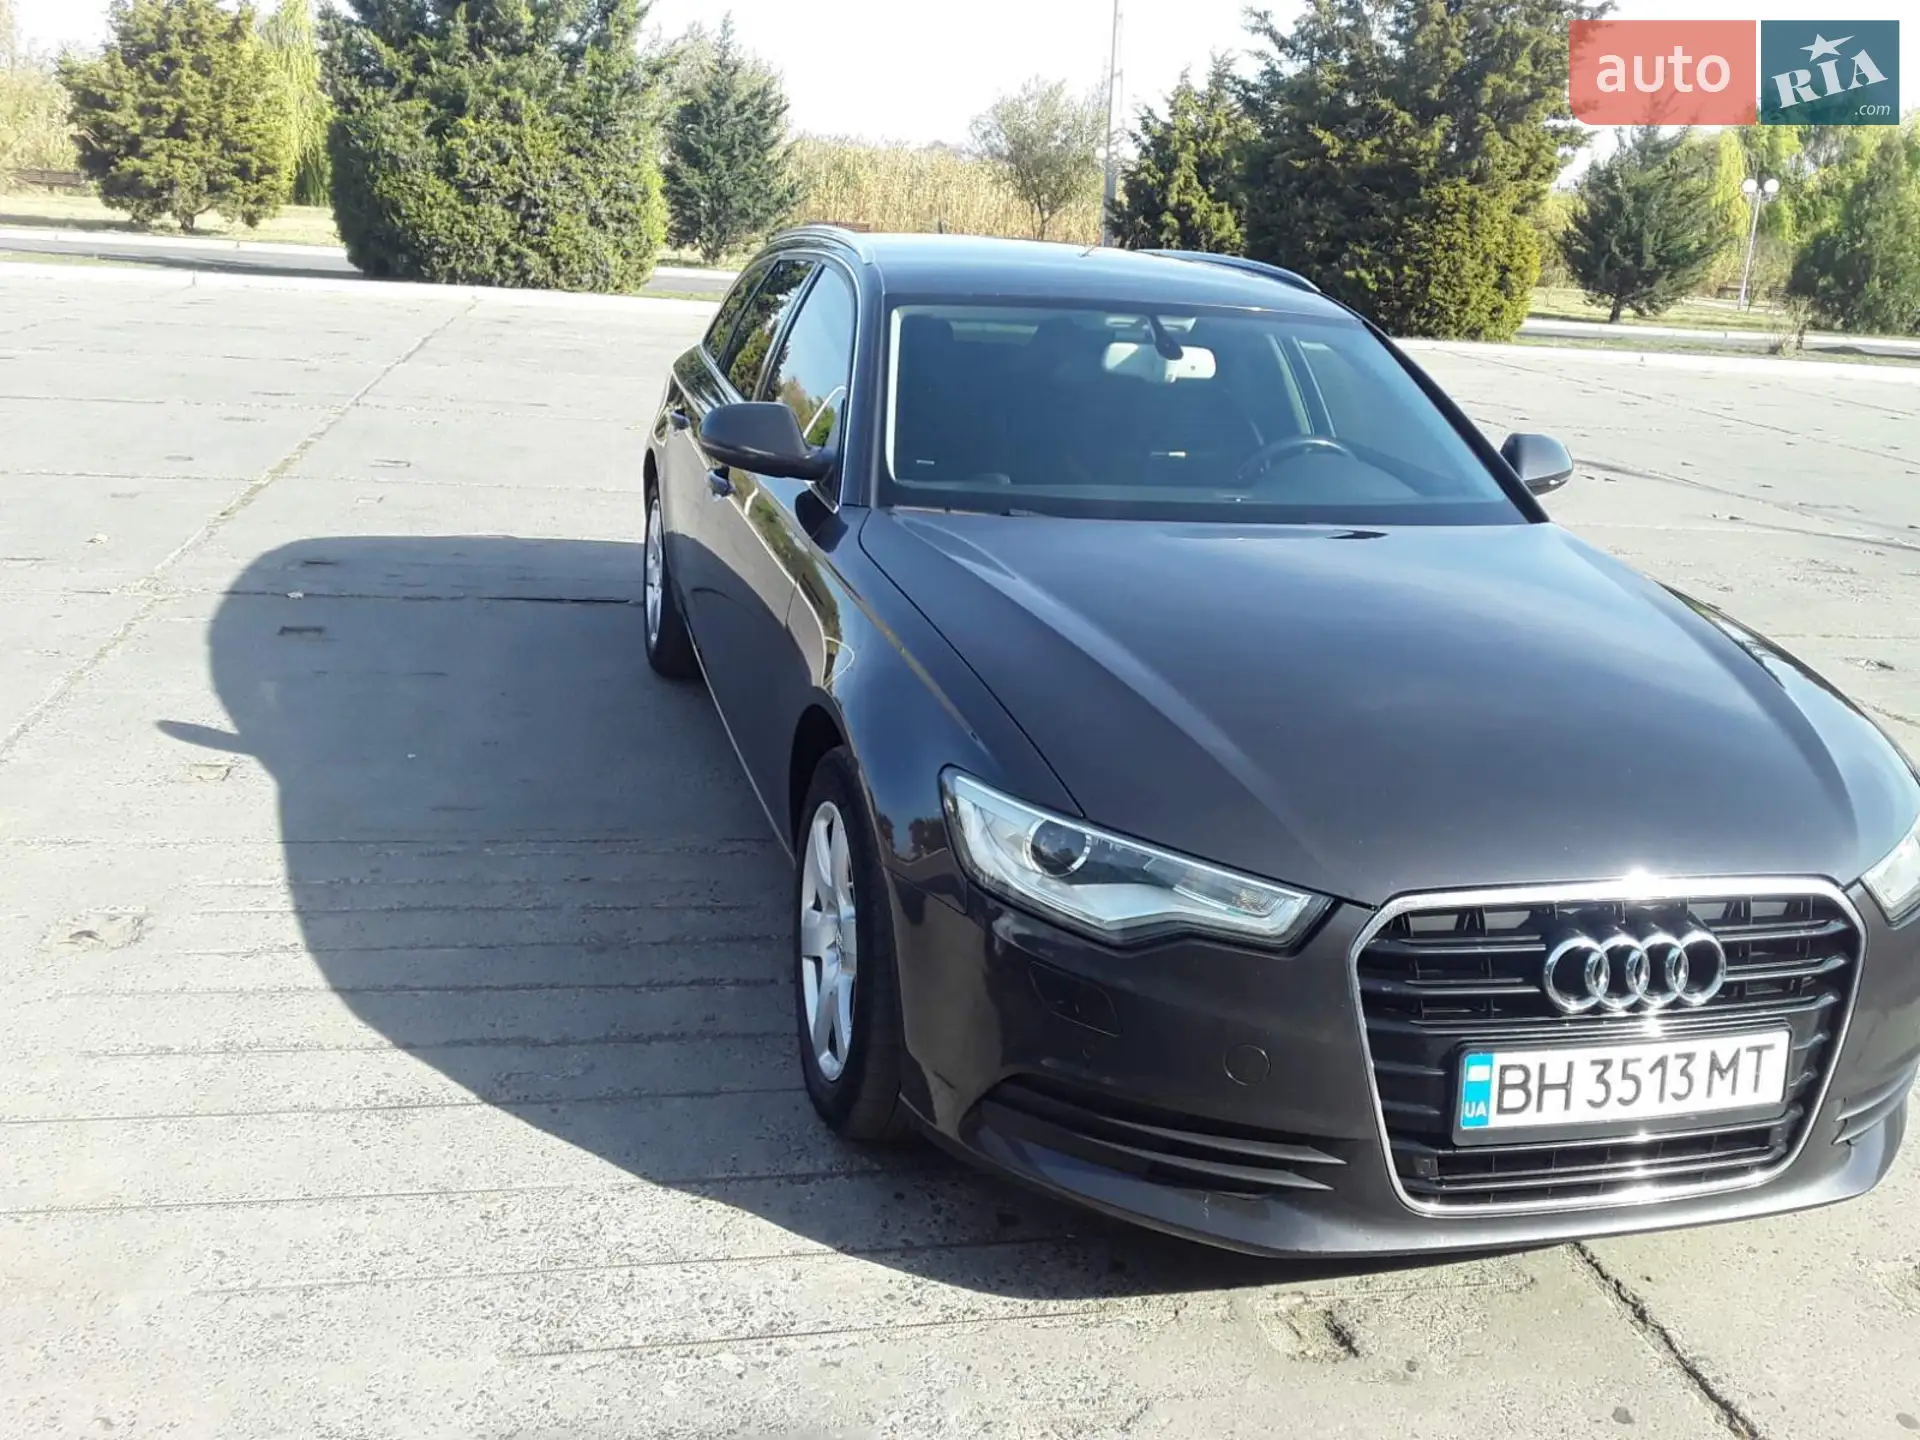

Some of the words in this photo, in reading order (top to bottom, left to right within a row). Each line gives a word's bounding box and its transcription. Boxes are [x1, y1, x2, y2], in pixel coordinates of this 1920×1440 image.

[1495, 1061, 1575, 1116] BH
[1586, 1052, 1697, 1109] 3513
[1706, 1043, 1777, 1099] MT
[1463, 1102, 1488, 1118] UA
